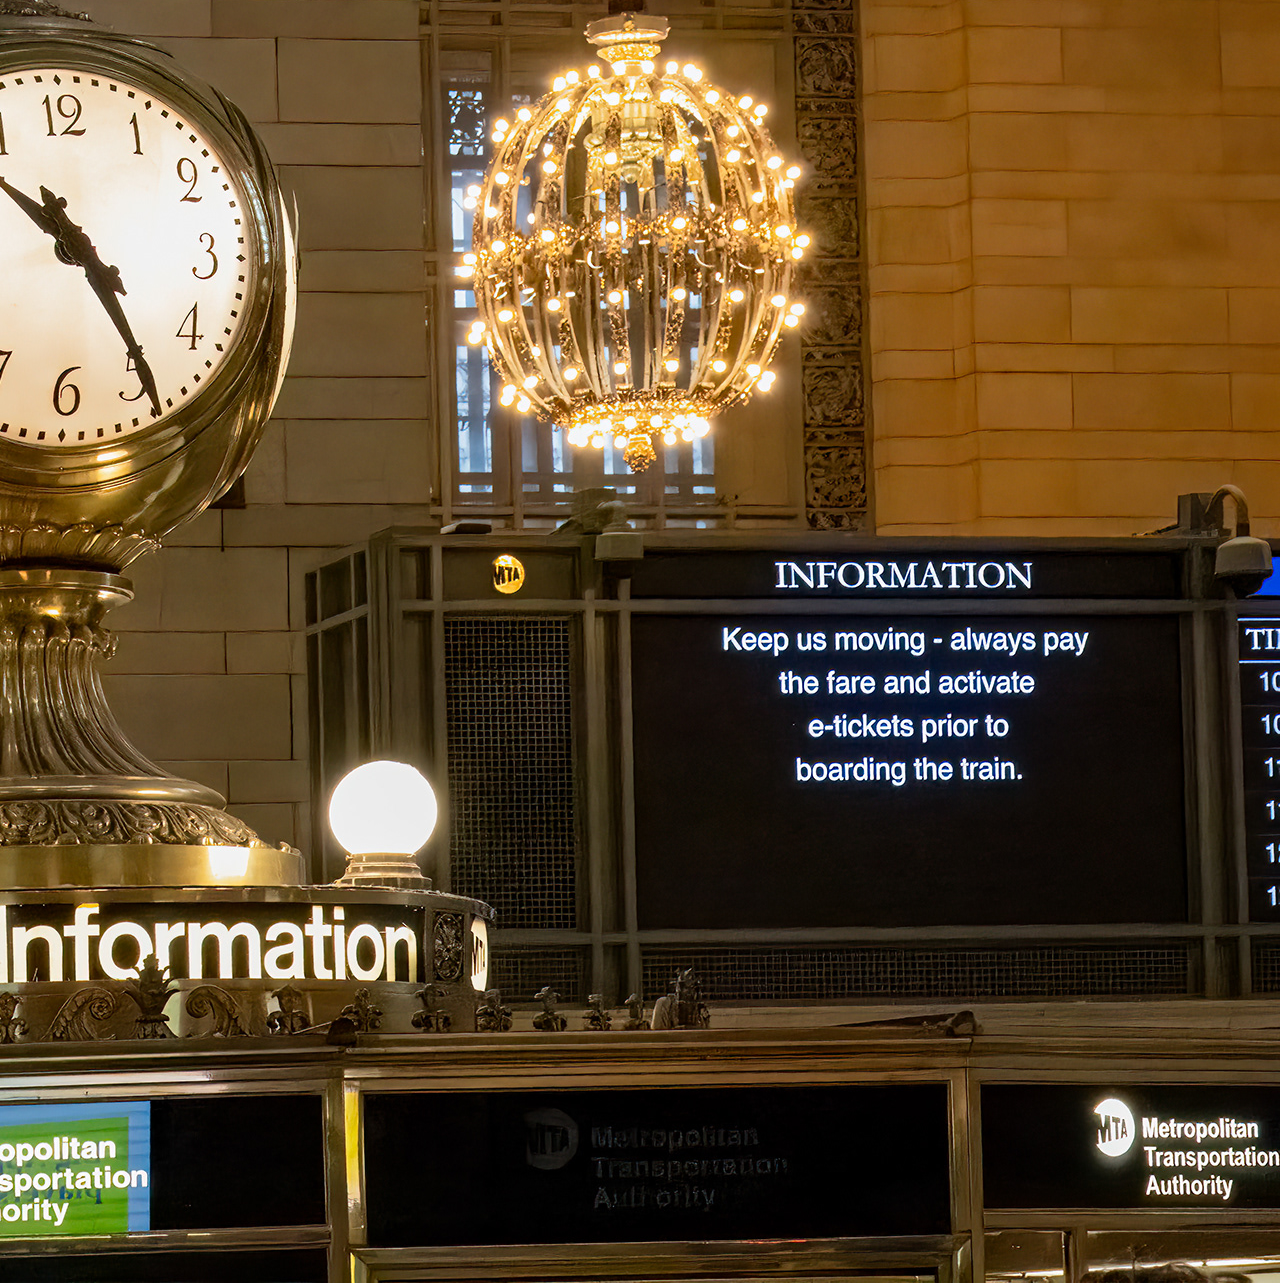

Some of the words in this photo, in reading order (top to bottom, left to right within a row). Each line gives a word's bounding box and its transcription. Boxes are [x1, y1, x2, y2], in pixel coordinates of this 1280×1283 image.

[42, 94, 86, 137] 12
[129, 112, 143, 155] 1
[176, 157, 203, 203] 2
[192, 232, 219, 279] 3
[176, 302, 204, 351] 4
[52, 366, 81, 416] 6
[774, 560, 1034, 590] INFORMATION
[721, 626, 790, 657] Keep
[796, 631, 828, 652] us
[834, 626, 926, 657] moving
[949, 626, 1037, 657] always
[1043, 631, 1090, 657] pay
[778, 669, 820, 695] the
[825, 669, 876, 695] fare
[883, 669, 931, 695] and
[937, 669, 1035, 695] activate
[807, 712, 915, 738] e-tickets
[921, 712, 979, 744] prior
[984, 714, 1010, 738] to
[795, 756, 907, 787] boarding
[913, 756, 954, 781] the
[959, 755, 1023, 781] train.
[1095, 1111, 1129, 1146] MTA
[1141, 1116, 1260, 1144] Metropolitan
[1143, 1146, 1280, 1172] Transportation
[1145, 1173, 1234, 1201] Authority
